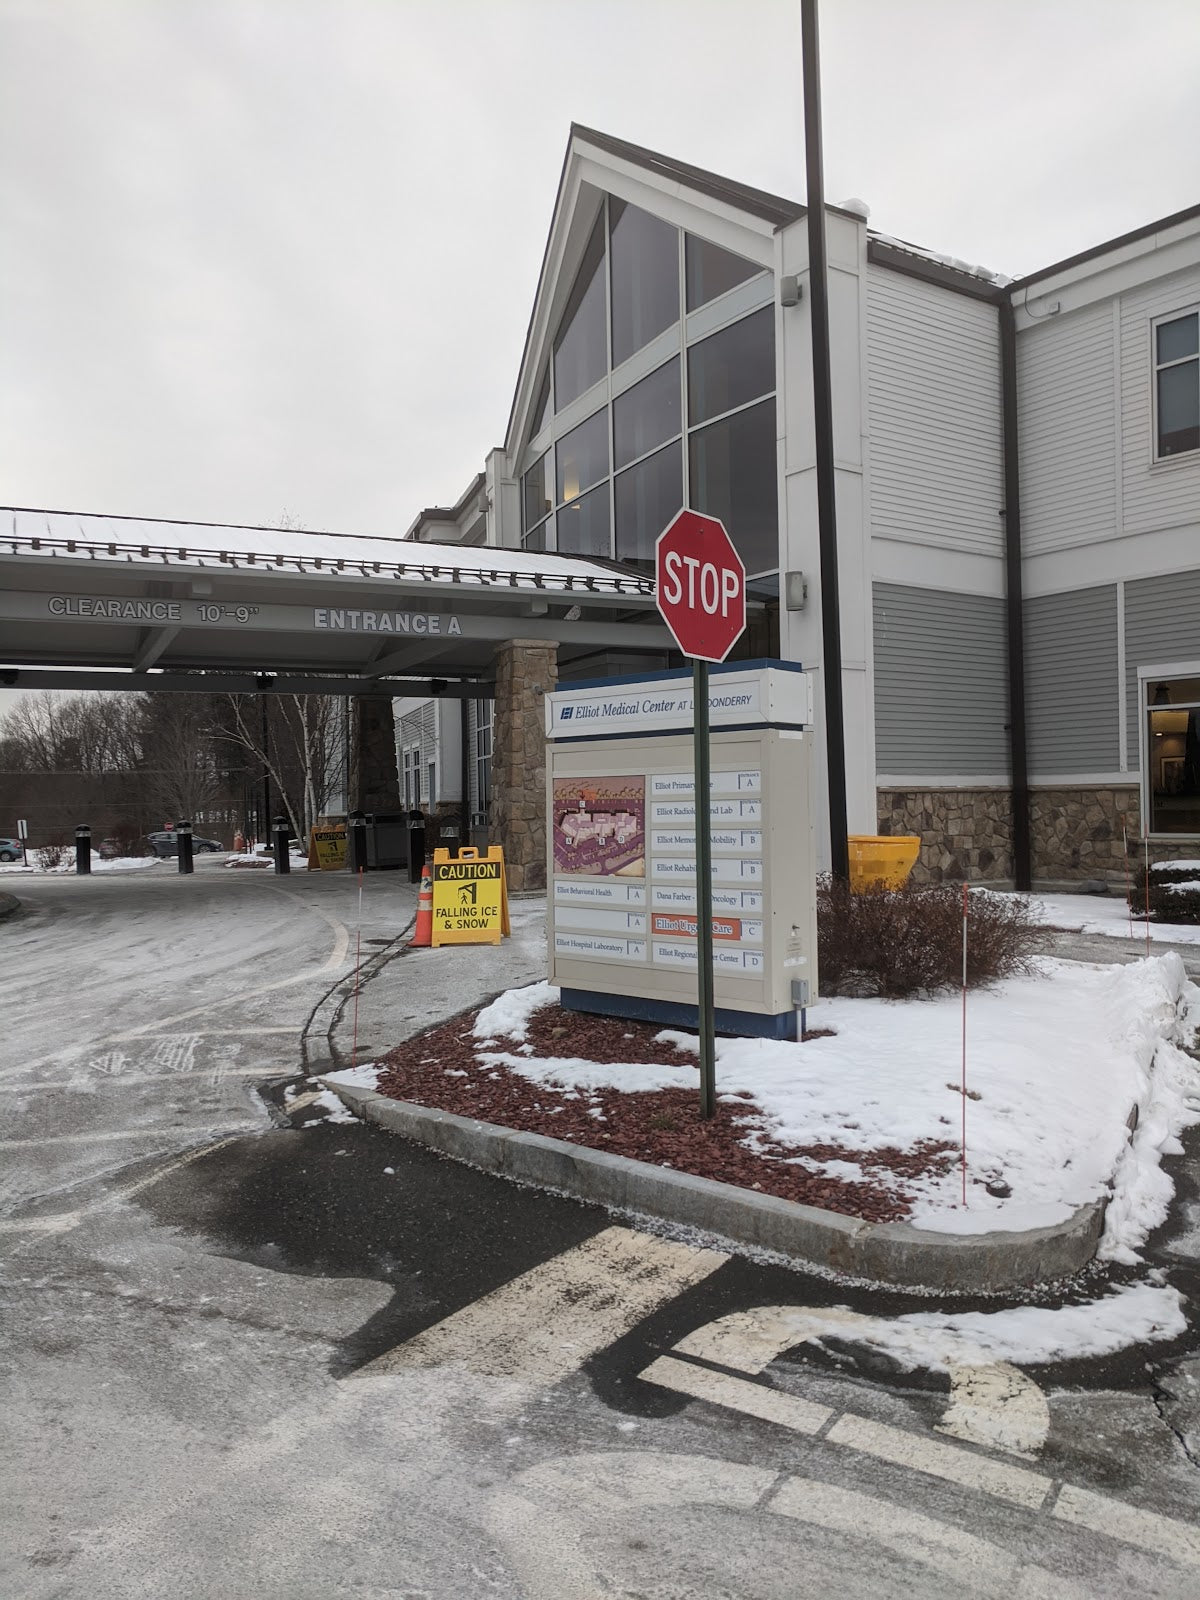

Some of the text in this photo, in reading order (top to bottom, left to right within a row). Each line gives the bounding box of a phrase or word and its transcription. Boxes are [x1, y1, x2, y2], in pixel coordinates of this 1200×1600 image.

[664, 551, 739, 618] STOP
[48, 597, 181, 620] CLEARANCE
[314, 609, 463, 635] ENTRANCE A
[576, 705, 600, 719] Elliot
[602, 701, 640, 717] Medical
[642, 700, 676, 713] Center
[678, 701, 688, 711] AT
[655, 782, 671, 790] Elliot
[747, 778, 753, 786] A
[656, 808, 673, 816] Elliot
[720, 806, 733, 815] Lab
[748, 805, 755, 813] A
[317, 832, 344, 841] CAUTION
[657, 836, 673, 844] Elliot
[750, 836, 756, 844] B
[439, 864, 496, 879] CAUTION
[656, 864, 673, 872] Elliot
[750, 866, 756, 874] B
[557, 886, 612, 897] Elliot Behavioral Health
[656, 892, 671, 900] Dana
[672, 892, 691, 901] Farber
[750, 897, 756, 905] B
[436, 906, 497, 918] FALLING ICE
[444, 918, 489, 930] & SNOW
[634, 918, 641, 926] A
[656, 919, 679, 930] Elliot
[712, 922, 733, 934] Care
[748, 927, 755, 935] C
[556, 938, 570, 946] Elliot
[570, 940, 593, 949] Hospital
[594, 942, 623, 953] Laboratory
[659, 948, 673, 956] Elliot
[674, 949, 698, 960] Regional
[719, 953, 739, 963] Center
[752, 957, 758, 966] D
